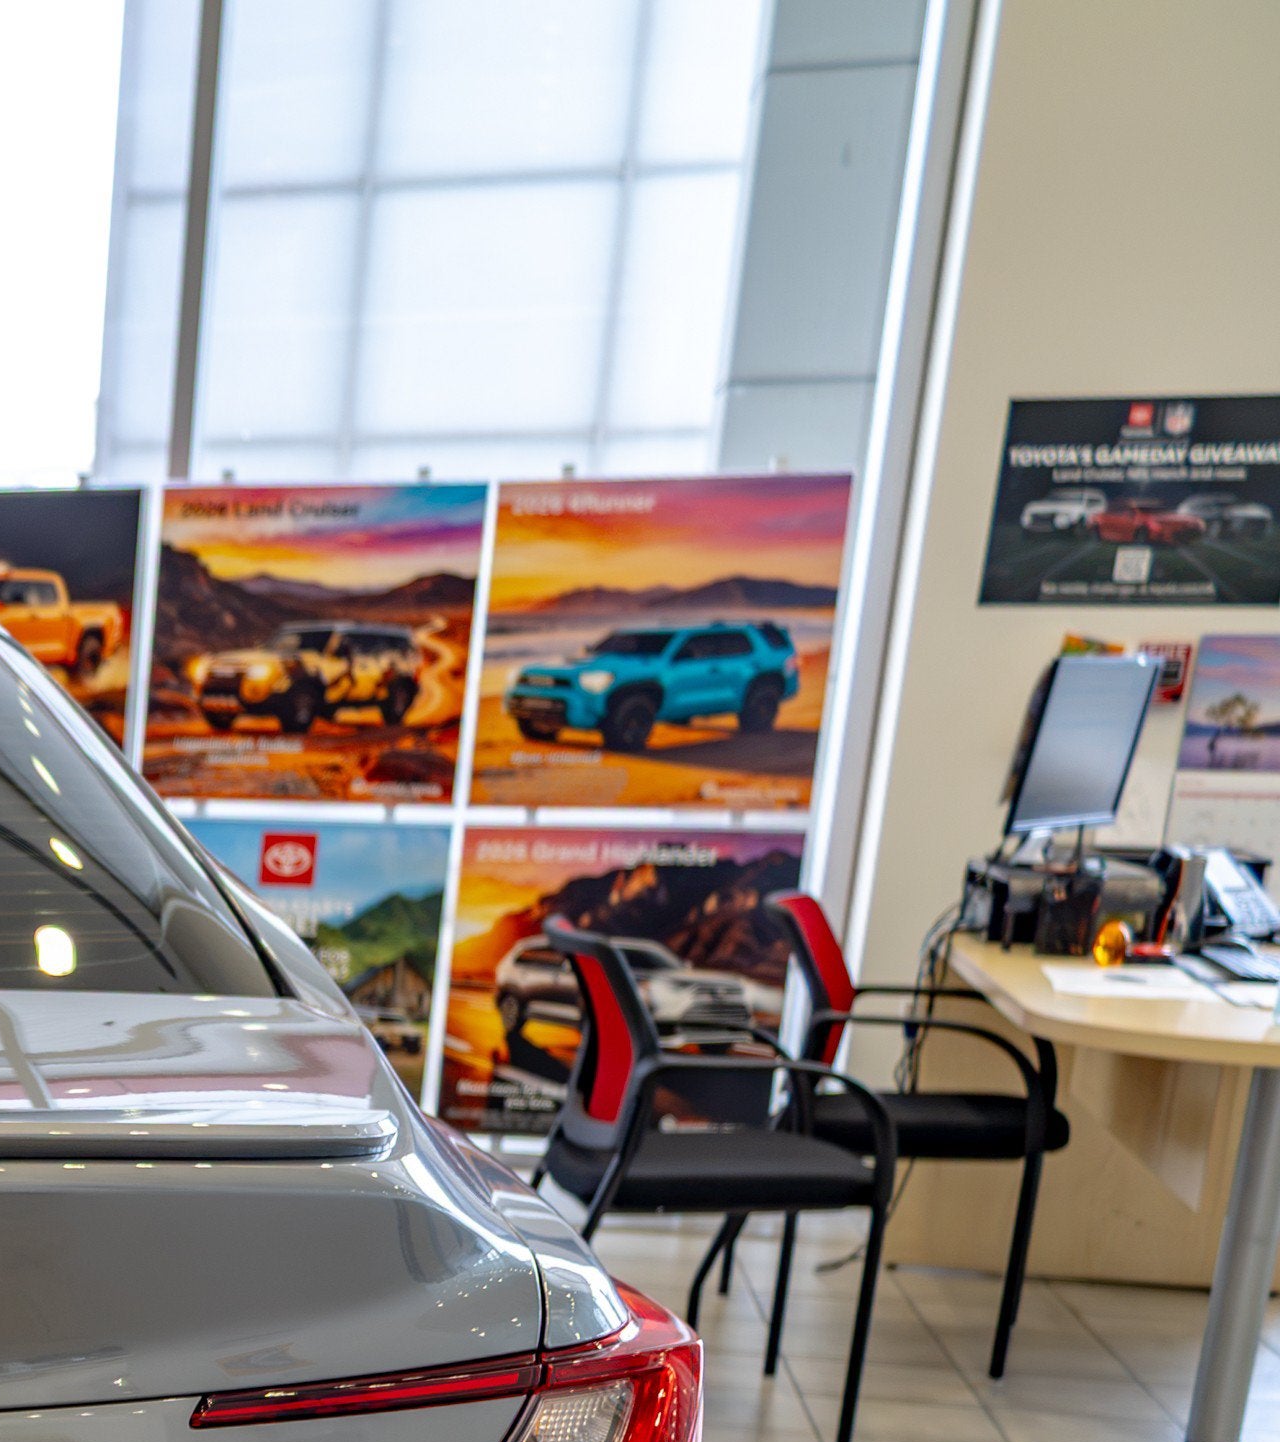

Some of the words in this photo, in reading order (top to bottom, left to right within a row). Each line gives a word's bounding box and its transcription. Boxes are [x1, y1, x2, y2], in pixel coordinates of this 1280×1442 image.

[1095, 444, 1187, 465] GAMEDAY
[1189, 443, 1280, 465] GIVEAWA
[234, 501, 284, 517] Land
[531, 841, 597, 861] Grand
[601, 841, 718, 867] Highlander
